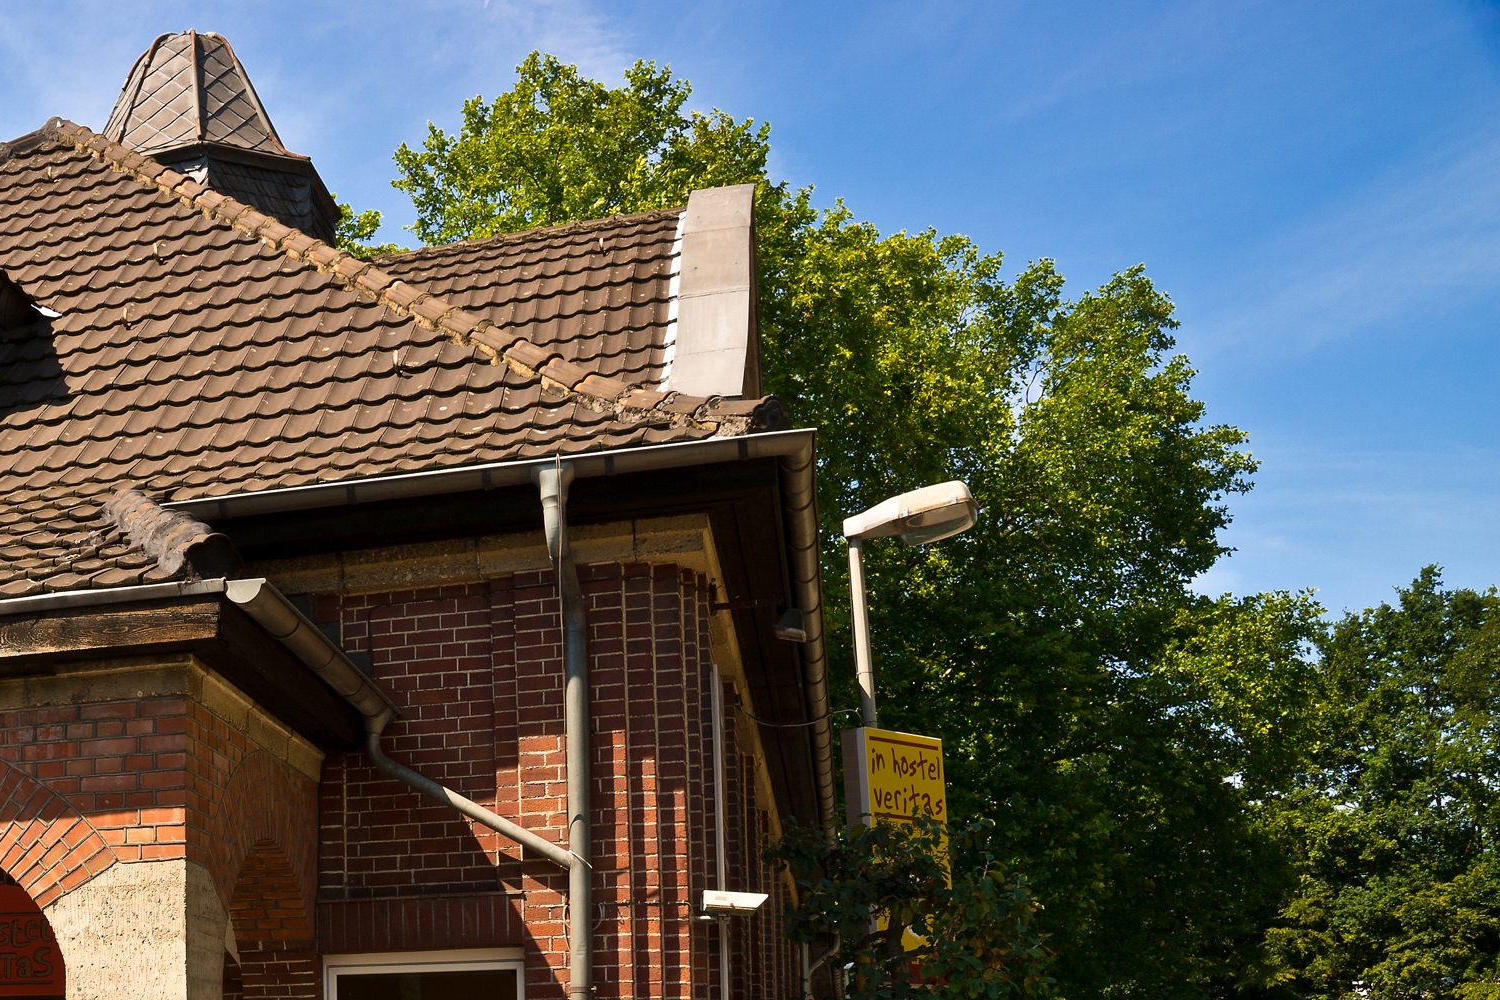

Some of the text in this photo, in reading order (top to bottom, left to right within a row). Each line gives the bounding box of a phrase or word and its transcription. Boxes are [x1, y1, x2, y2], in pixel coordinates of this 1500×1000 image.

[871, 747, 941, 781] in hostel
[873, 784, 943, 816] veritas
